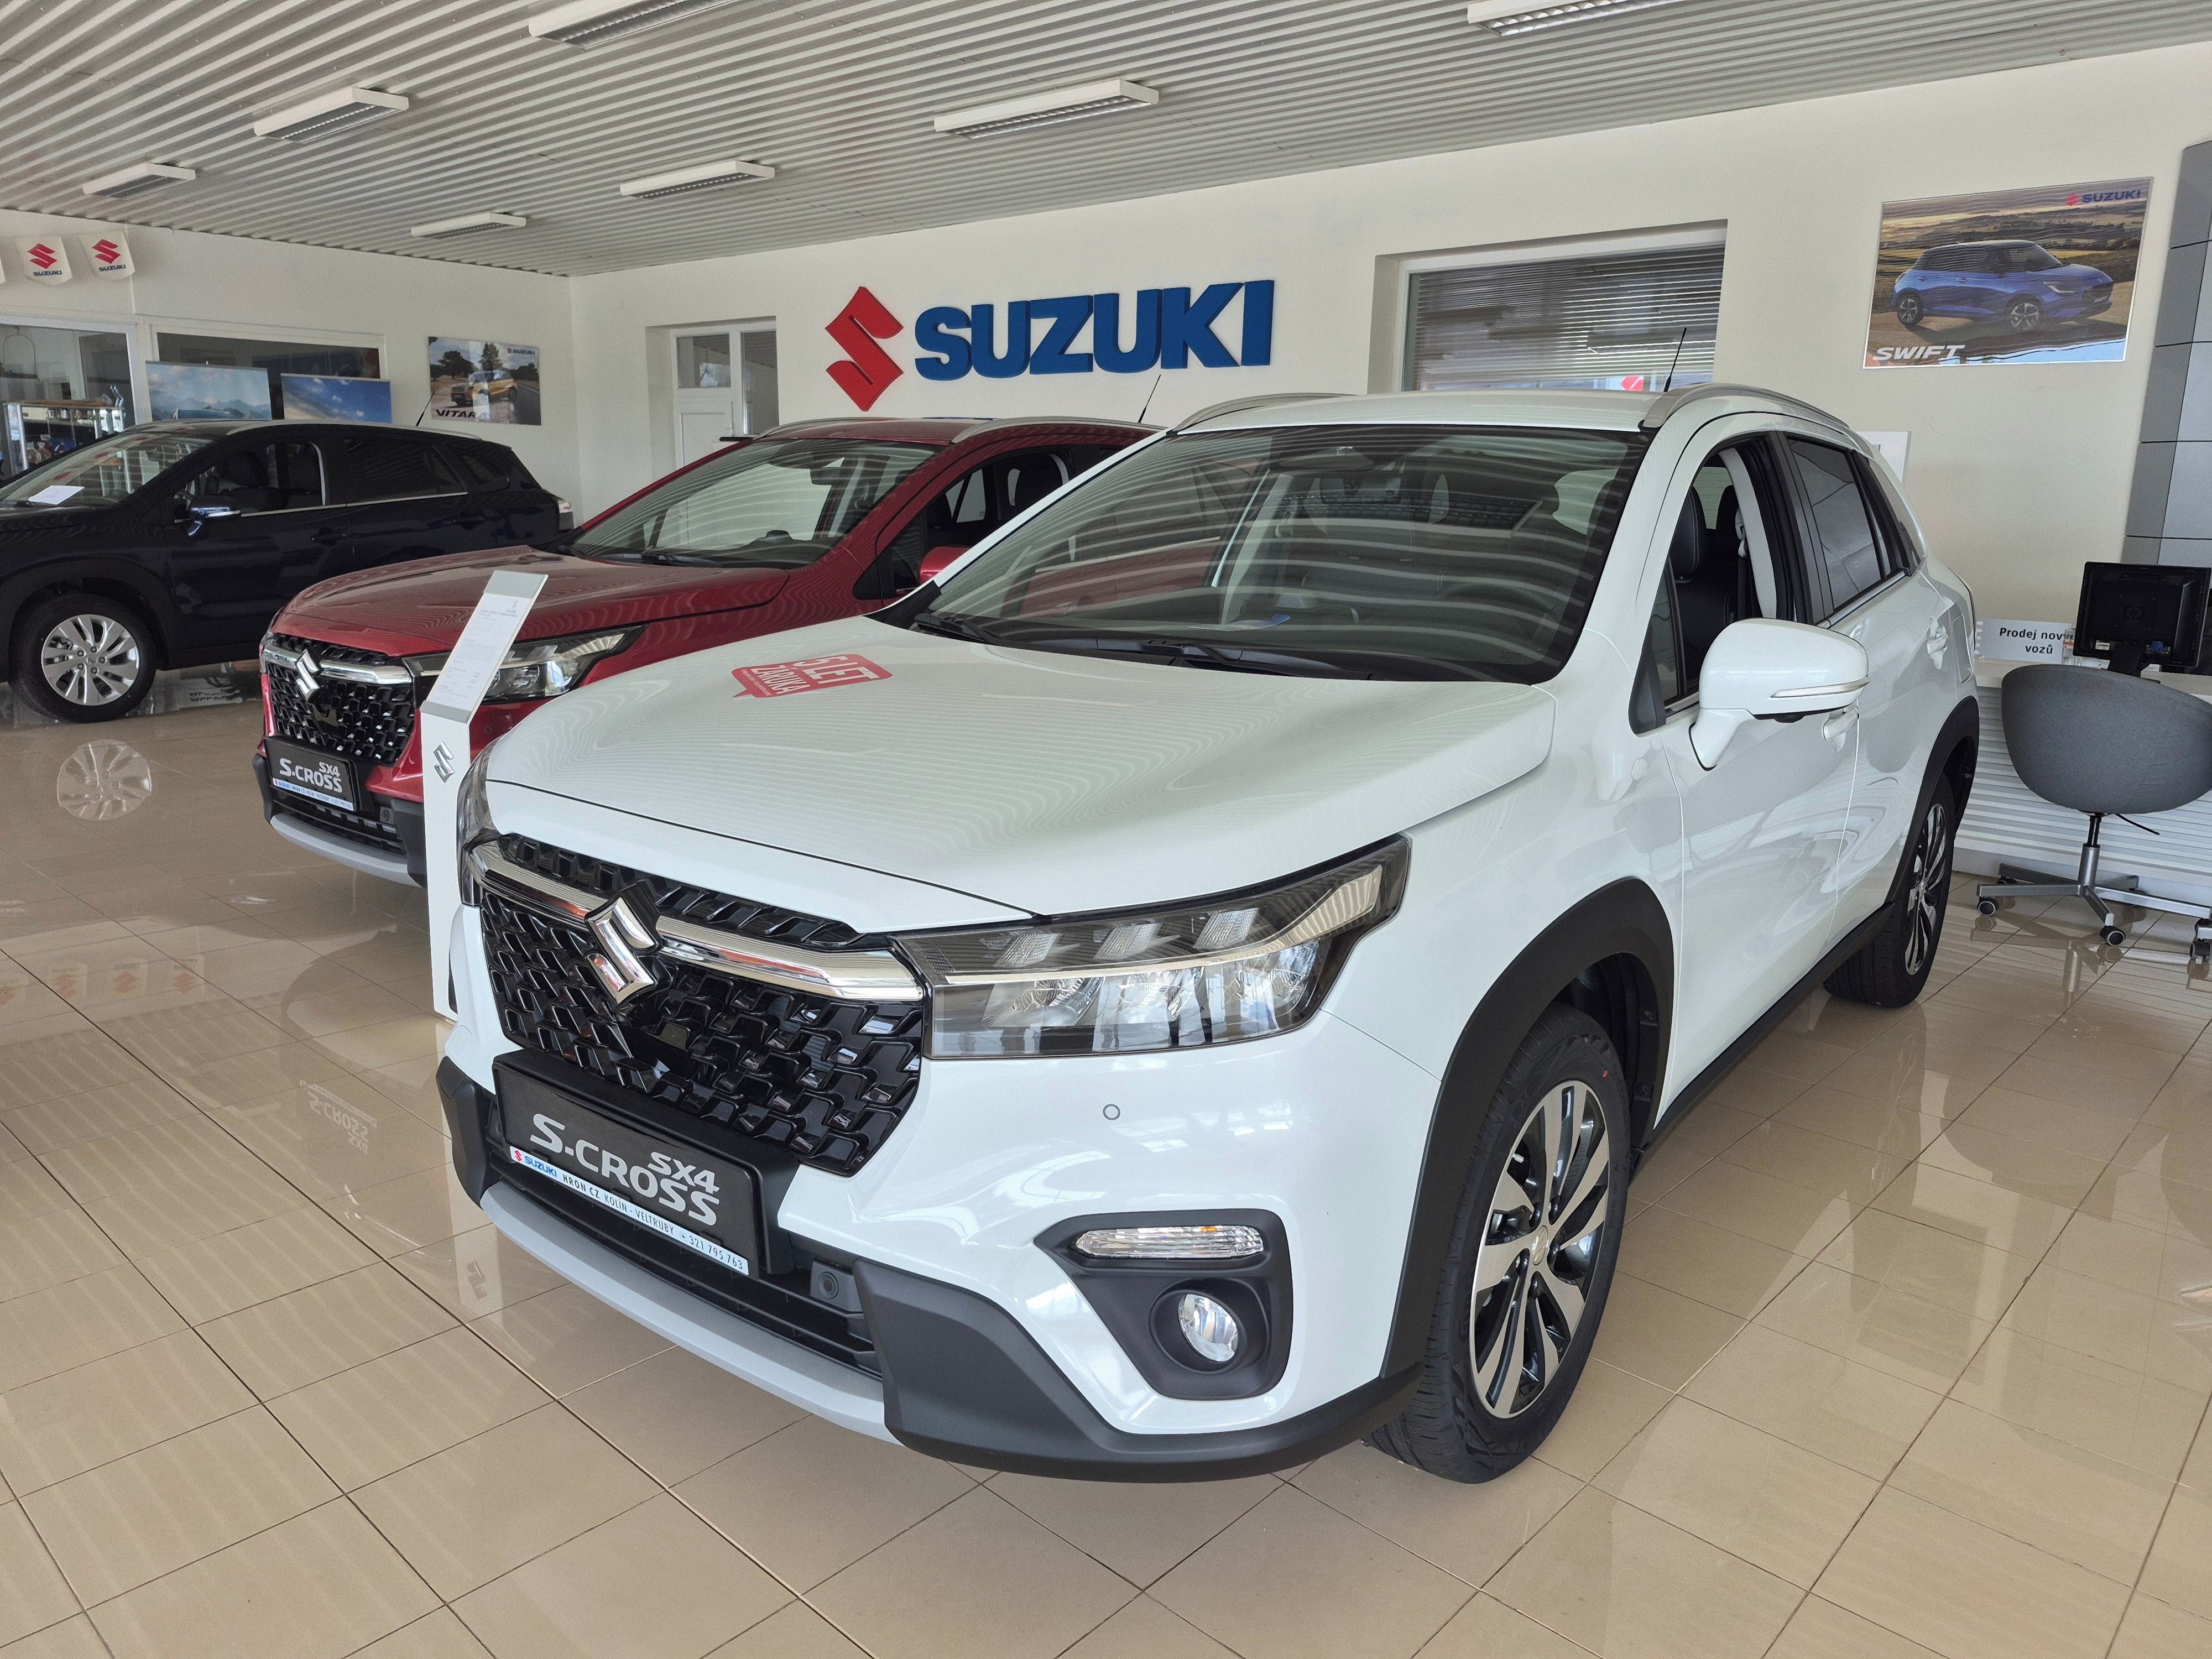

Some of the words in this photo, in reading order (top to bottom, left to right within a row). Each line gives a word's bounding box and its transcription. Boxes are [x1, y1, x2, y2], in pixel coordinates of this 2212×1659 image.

[2081, 190, 2141, 204] SUZUKI
[915, 280, 1274, 381] SUZUKI
[1873, 344, 1965, 361] SWIFT
[2000, 627, 2037, 640] Prodej
[2026, 644, 2053, 654] vozů
[793, 656, 849, 666] 5
[750, 665, 811, 695] ZÁRUKA
[802, 662, 880, 684] LET
[319, 761, 341, 778] SX4
[648, 1151, 719, 1194] SX4
[525, 1156, 557, 1177] SUZUKI
[563, 1174, 586, 1192] HRON
[589, 1187, 599, 1199] CZ
[604, 1193, 627, 1213] KOLÍN
[635, 1208, 674, 1235] VELTRUBY
[689, 1235, 704, 1250] 321
[708, 1245, 723, 1260] 795
[727, 1254, 743, 1270] 763
